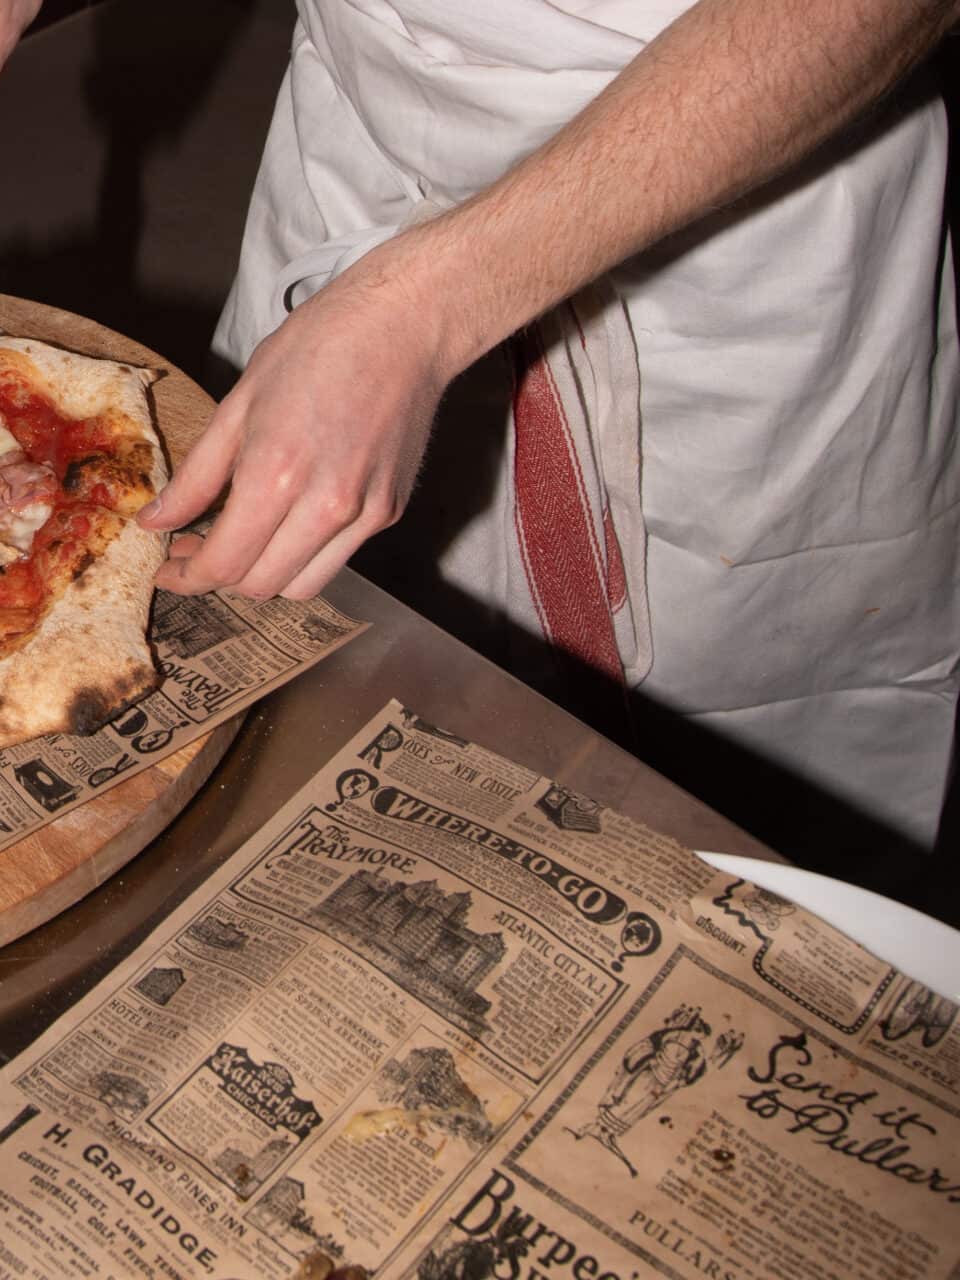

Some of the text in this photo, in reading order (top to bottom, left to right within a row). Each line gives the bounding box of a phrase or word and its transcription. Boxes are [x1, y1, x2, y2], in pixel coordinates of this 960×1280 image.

[153, 657, 230, 716] TRAYMO
[179, 685, 202, 711] The
[450, 762, 481, 783] NEW
[479, 777, 522, 802] CASTLE
[325, 825, 350, 848] The
[383, 790, 613, 922] WHERE-TO-GO
[490, 910, 555, 958] ATLANTIC
[695, 916, 747, 957] DISCOUNT.
[107, 999, 143, 1027] HOTEL
[224, 1081, 278, 1127] CHICAGO
[747, 1029, 937, 1140] Send it
[43, 1123, 72, 1148] H.
[82, 1143, 218, 1274] GRADIDGE,
[103, 1116, 176, 1172] HIGHLAND
[177, 1171, 219, 1215] PINES
[219, 1213, 247, 1238] INN
[29, 1174, 78, 1214] FOOTBALL,
[87, 1216, 116, 1245] GOLF,
[115, 1218, 146, 1249] LAWN
[154, 1255, 183, 1280] TENN
